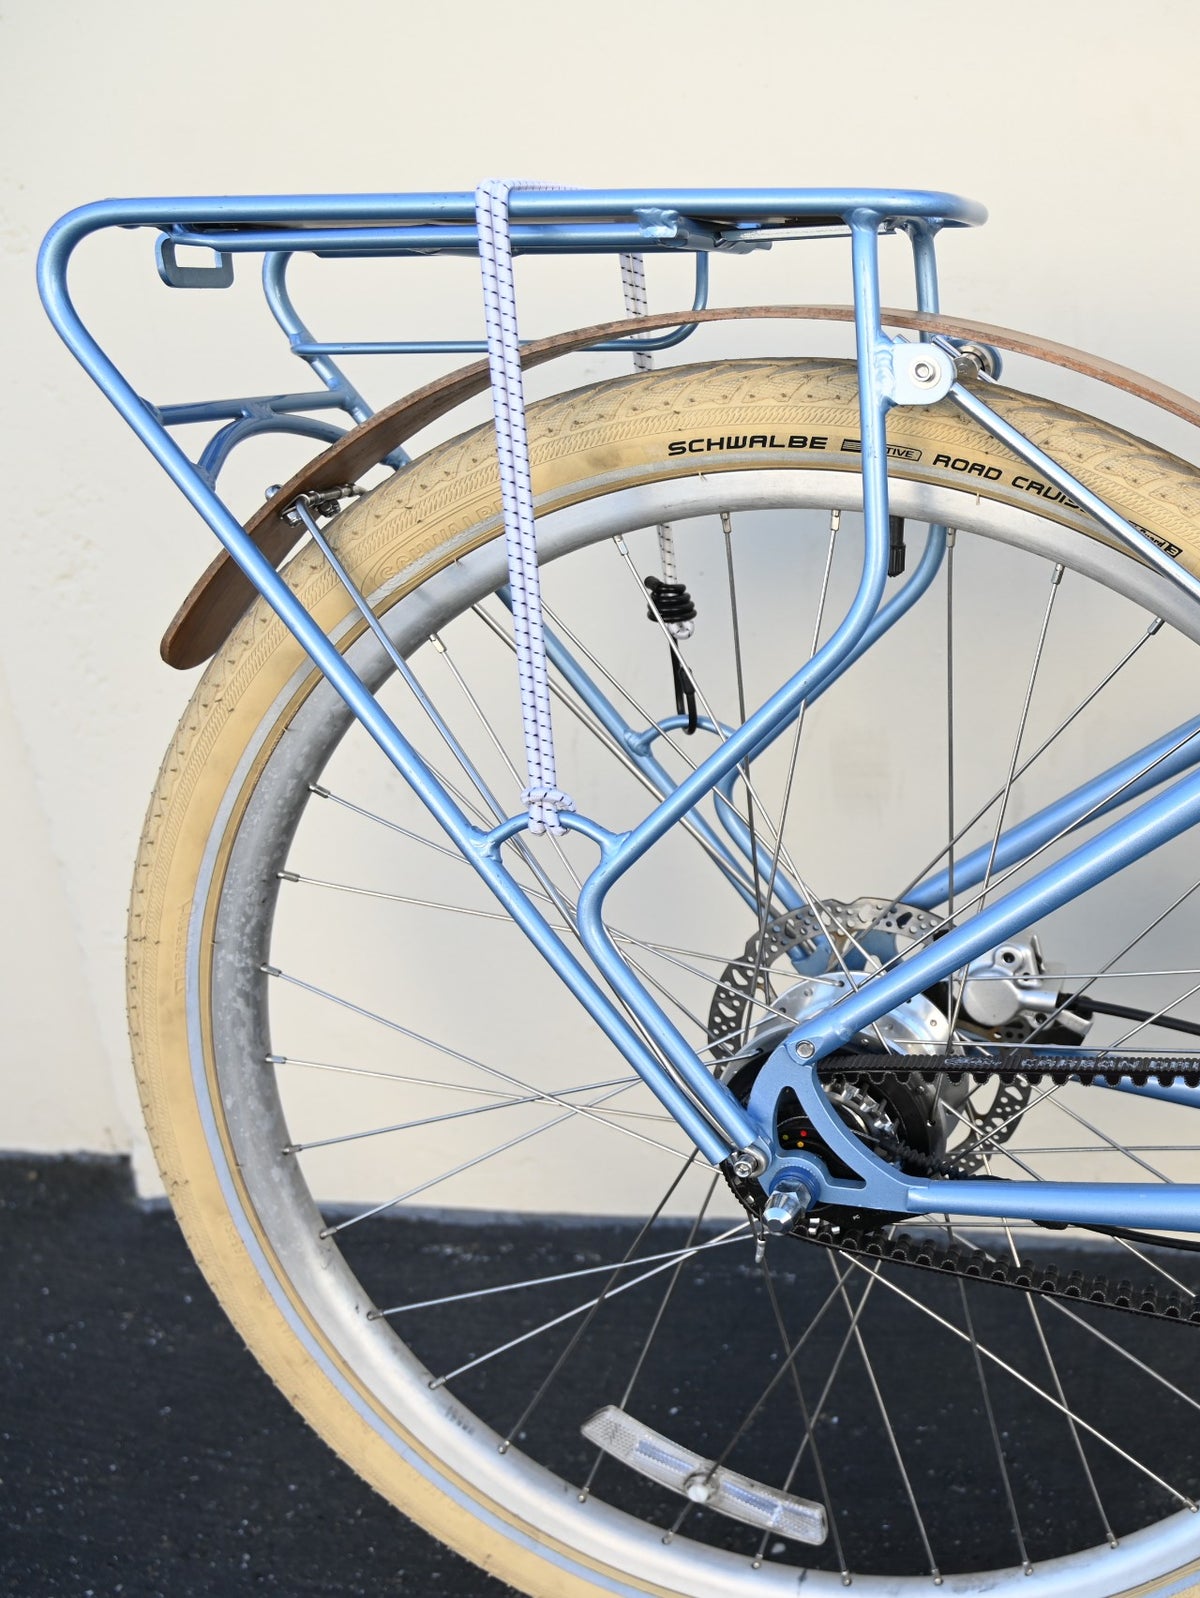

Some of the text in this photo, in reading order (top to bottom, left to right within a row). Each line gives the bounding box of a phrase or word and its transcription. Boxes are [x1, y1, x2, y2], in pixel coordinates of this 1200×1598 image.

[667, 434, 829, 457] SCHWALBE
[885, 446, 914, 459] TIVE
[932, 453, 1003, 481] ROAD
